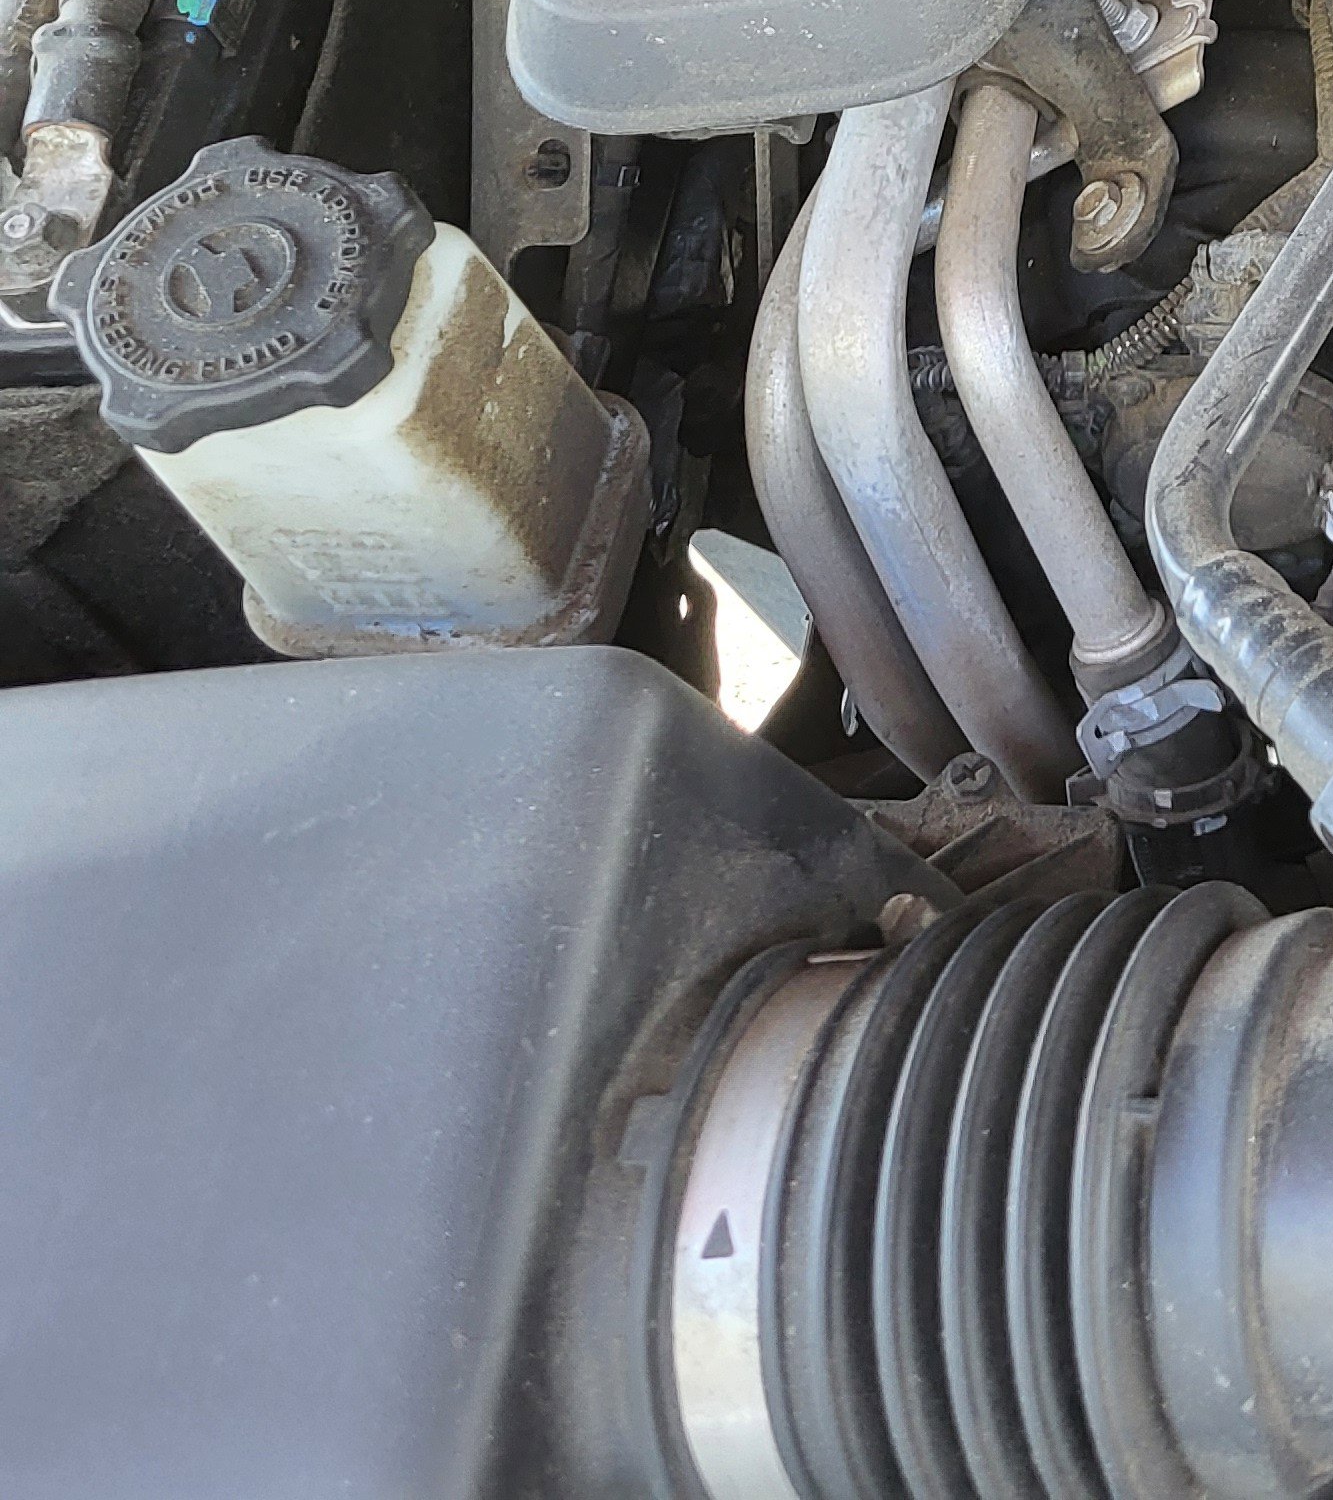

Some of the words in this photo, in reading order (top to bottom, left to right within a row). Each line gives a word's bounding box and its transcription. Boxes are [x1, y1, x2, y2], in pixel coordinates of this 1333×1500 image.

[244, 167, 308, 193] USE
[312, 185, 369, 315] APPROVED
[97, 274, 183, 381] STEERING
[195, 331, 298, 381] FLUID
